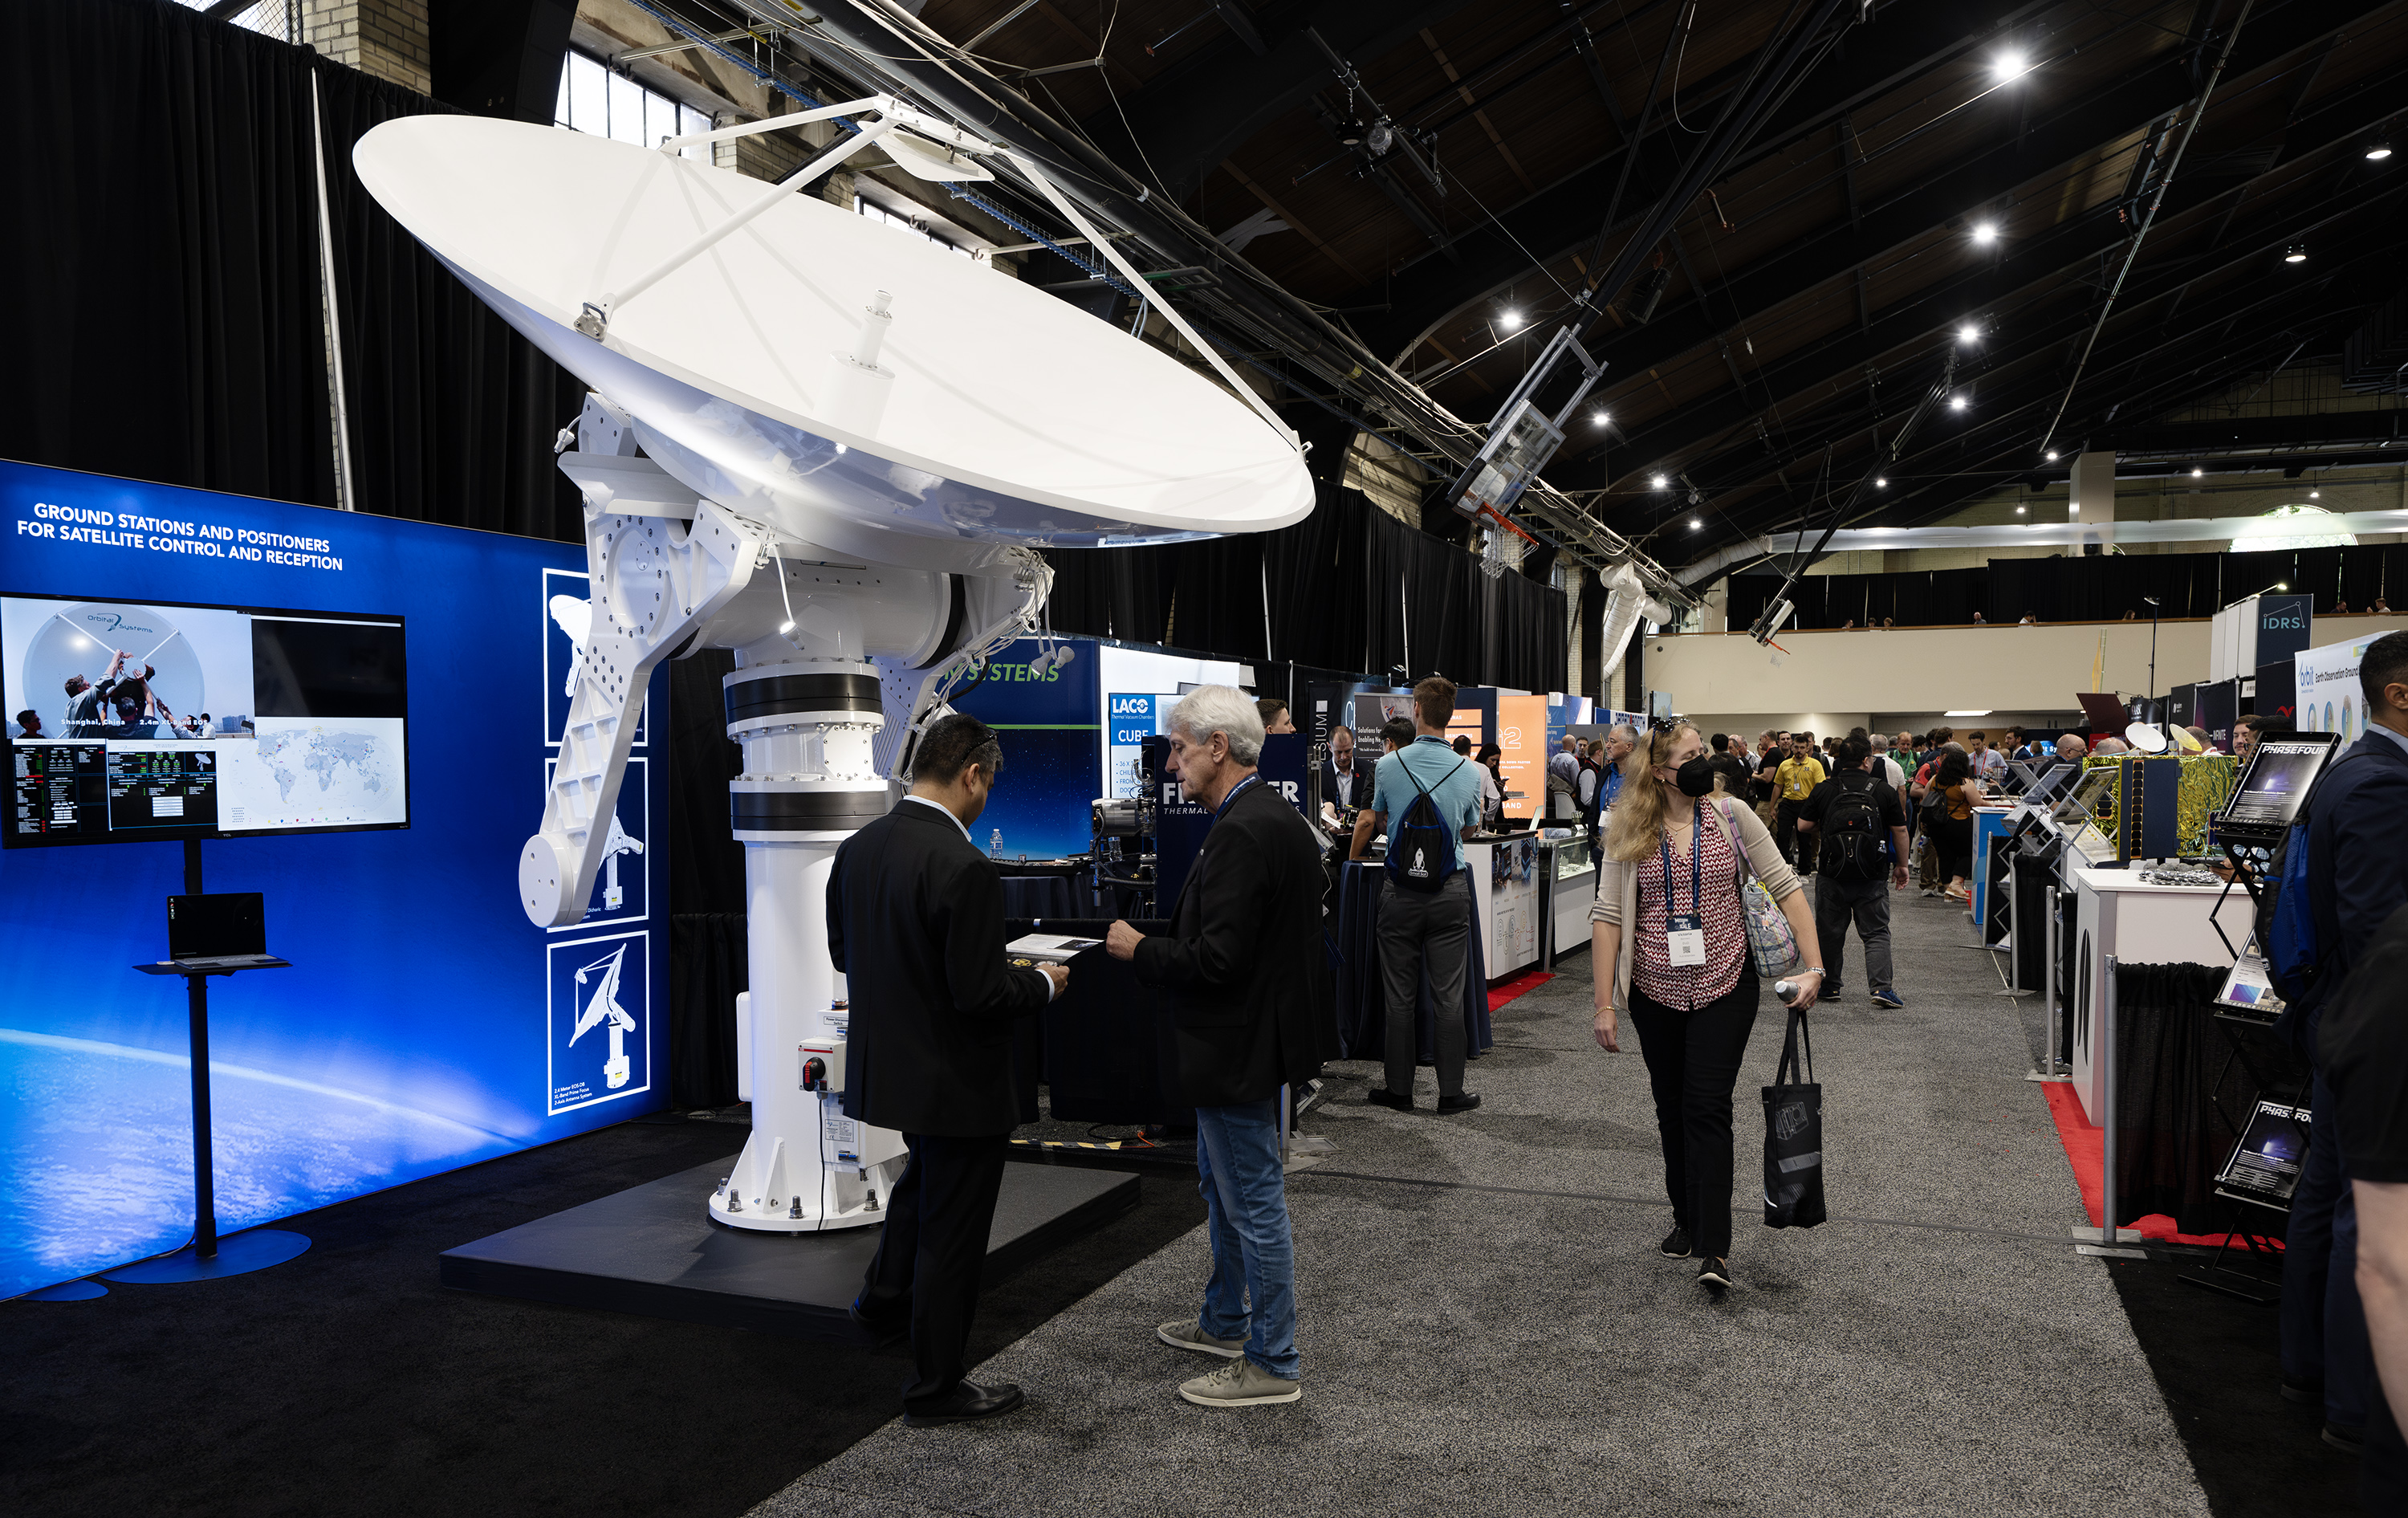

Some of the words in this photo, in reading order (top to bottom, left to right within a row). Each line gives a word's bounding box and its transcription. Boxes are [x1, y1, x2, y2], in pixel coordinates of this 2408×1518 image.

[34, 503, 113, 526] GROUND
[118, 514, 195, 536] STATIONS
[199, 524, 234, 541] AND
[238, 528, 330, 553] POSITIONERS
[17, 520, 55, 539] FOR
[59, 525, 144, 549] SATELLITE
[148, 536, 225, 558] CONTROL
[228, 546, 262, 561] AND
[266, 550, 343, 571] RECEPTION
[87, 614, 114, 624] Orbital
[119, 624, 153, 633] Systems
[2315, 672, 2324, 683] Earth
[2325, 668, 2344, 681] Observation
[2345, 665, 2359, 678] Ground
[1112, 698, 1149, 714] LACO
[2262, 745, 2328, 755] PHASEFOUR
